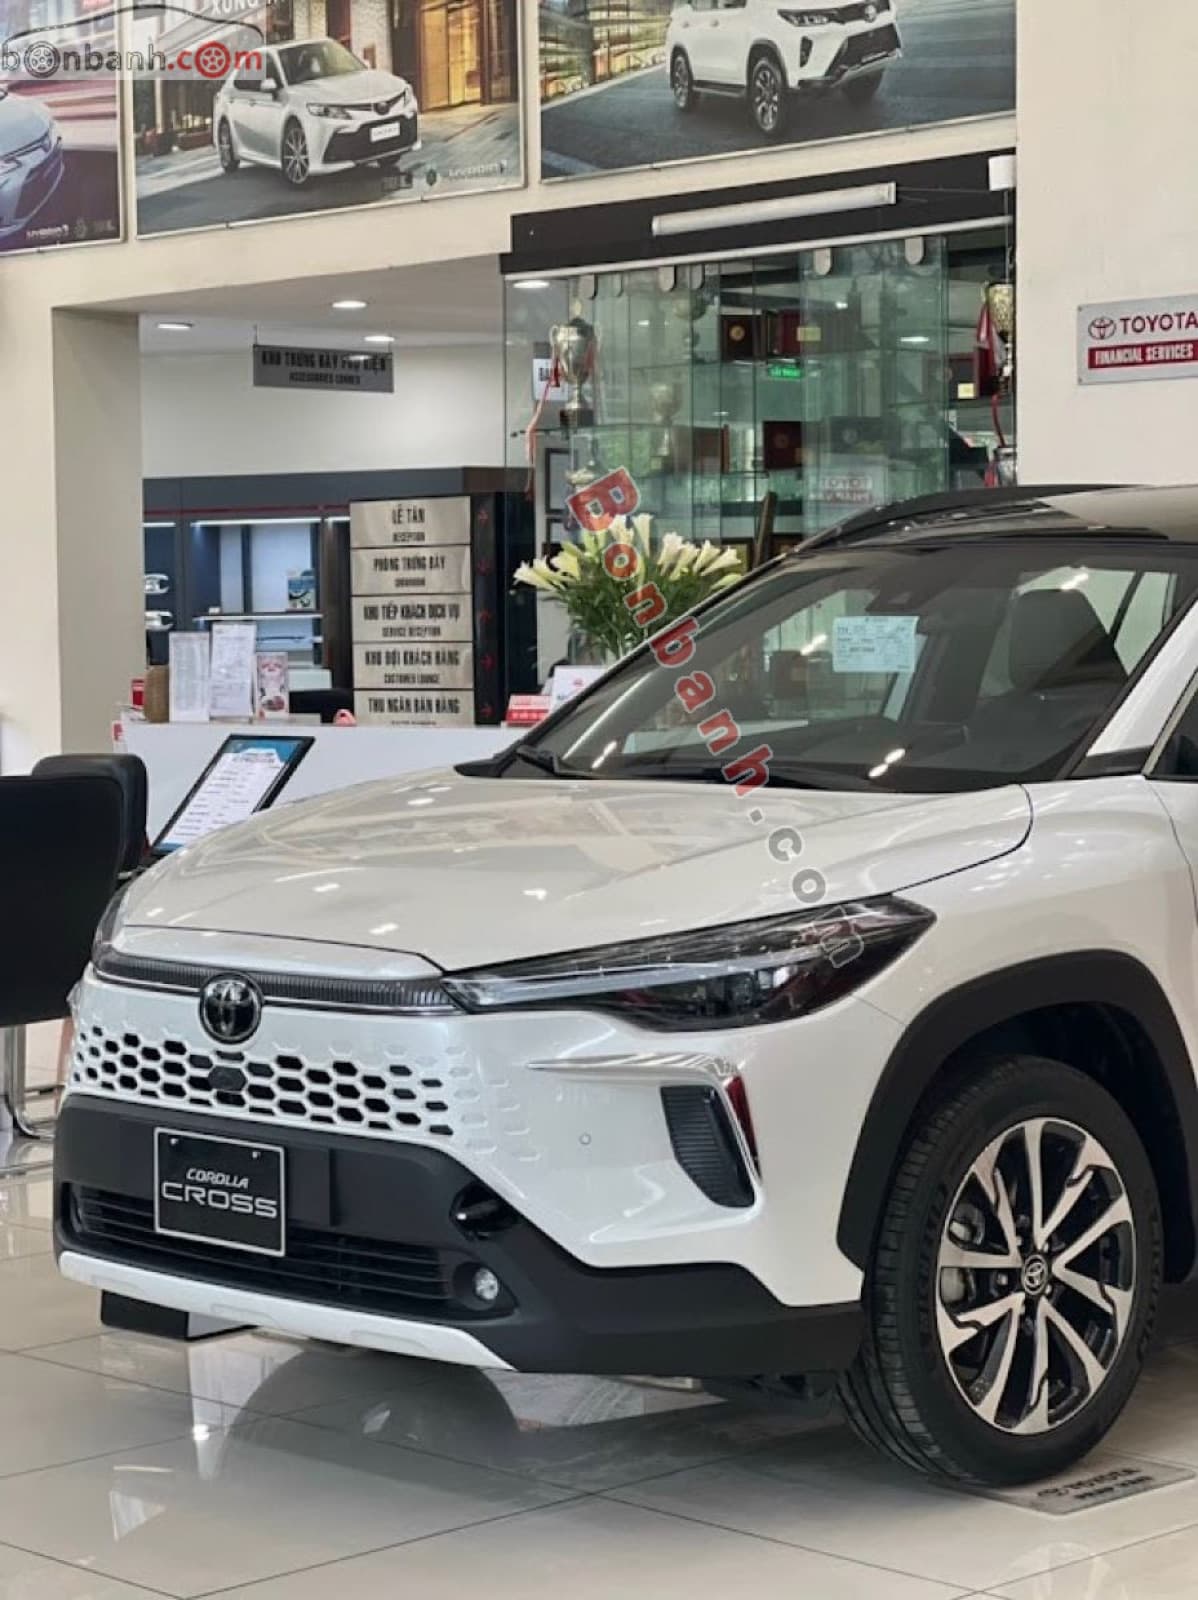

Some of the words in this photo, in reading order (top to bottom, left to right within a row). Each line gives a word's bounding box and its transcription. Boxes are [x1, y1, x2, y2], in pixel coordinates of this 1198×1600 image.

[1119, 311, 1198, 335] TOYOTA
[1095, 347, 1142, 366] FINANCIAL
[1146, 343, 1194, 361] SERVICES
[185, 1167, 250, 1190] COROLLA
[161, 1180, 278, 1219] CROSS
